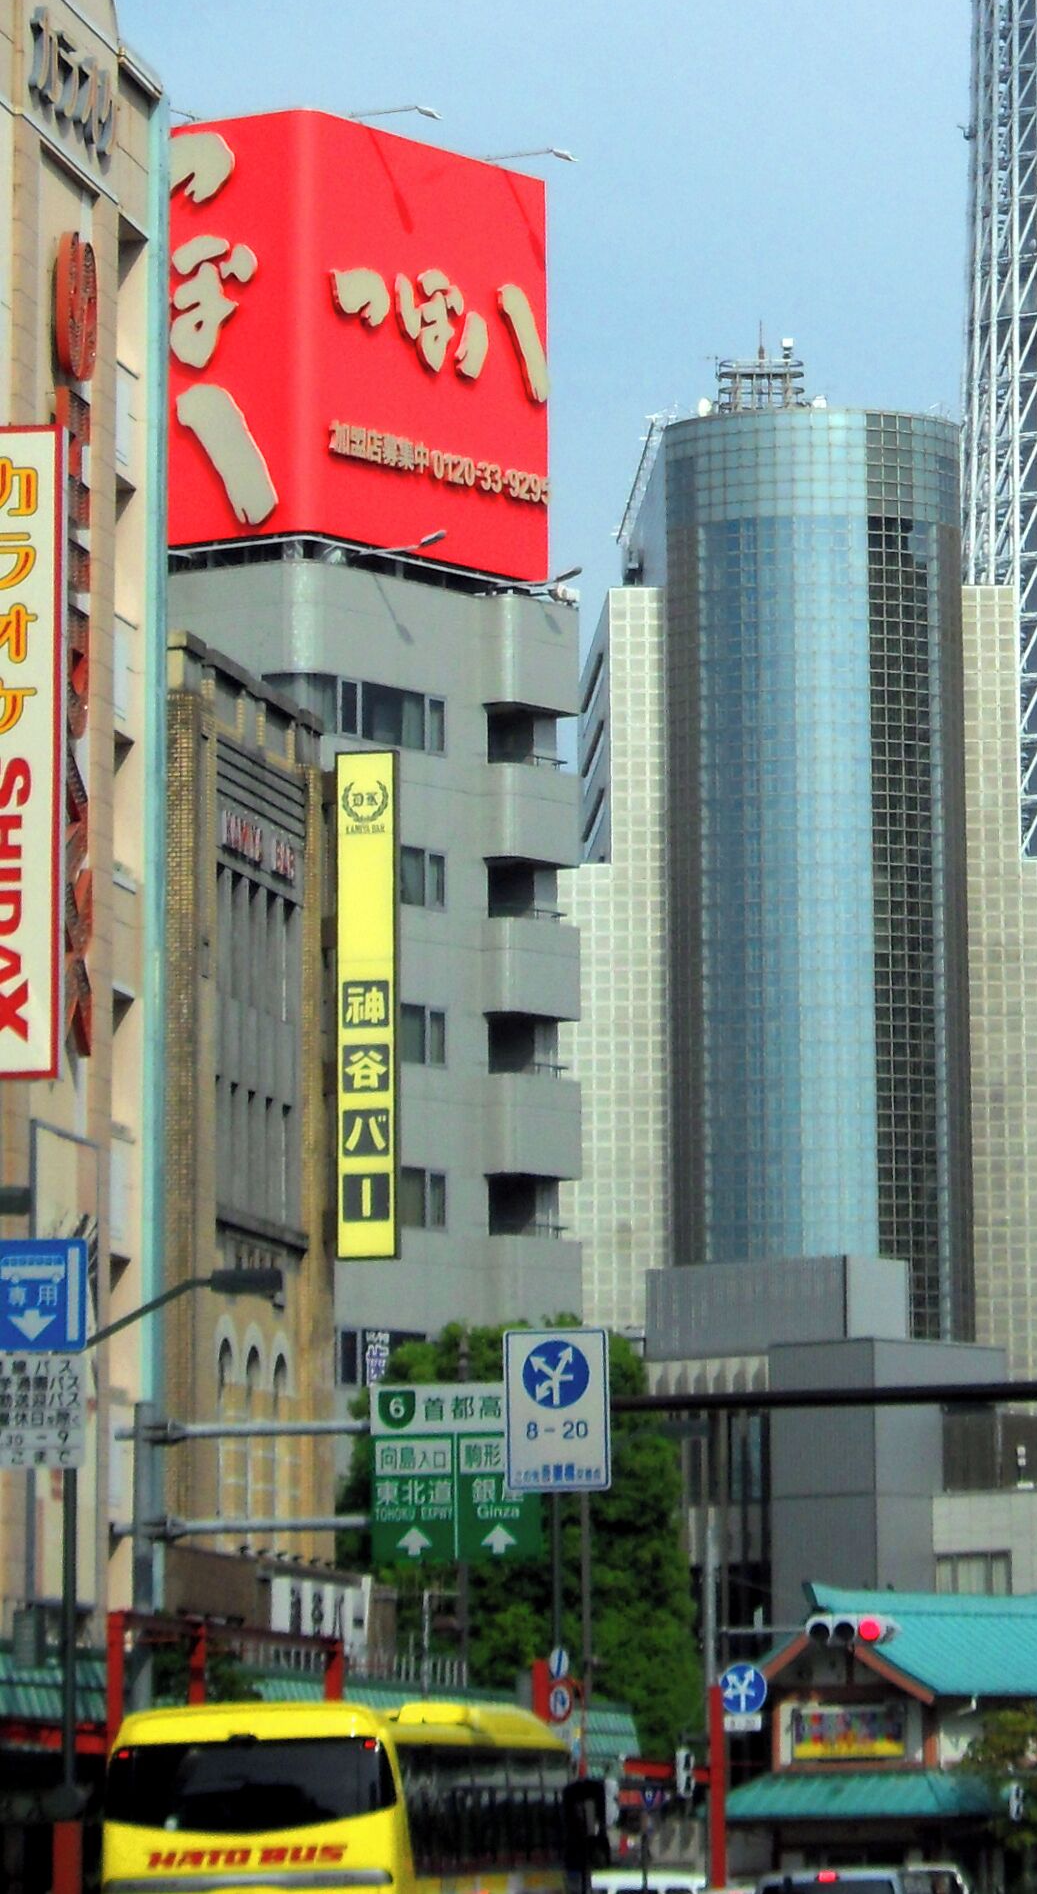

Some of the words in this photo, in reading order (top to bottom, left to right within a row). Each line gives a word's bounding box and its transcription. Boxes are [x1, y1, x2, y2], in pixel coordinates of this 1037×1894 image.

[330, 267, 548, 403] つぼ八
[328, 420, 430, 474] 加盟店募集中
[371, 823, 386, 834] BAR
[344, 985, 388, 1218] 神谷バー
[8, 1284, 58, 1306] 専用
[389, 1396, 405, 1419] 6
[424, 1395, 500, 1422] 首都高
[380, 1445, 447, 1470] 向島入口
[464, 1443, 501, 1468] 駒形
[375, 1478, 452, 1505] 東北道
[477, 1504, 520, 1519] Ginza
[148, 1849, 252, 1870] HATO
[258, 1844, 347, 1866] BUS
